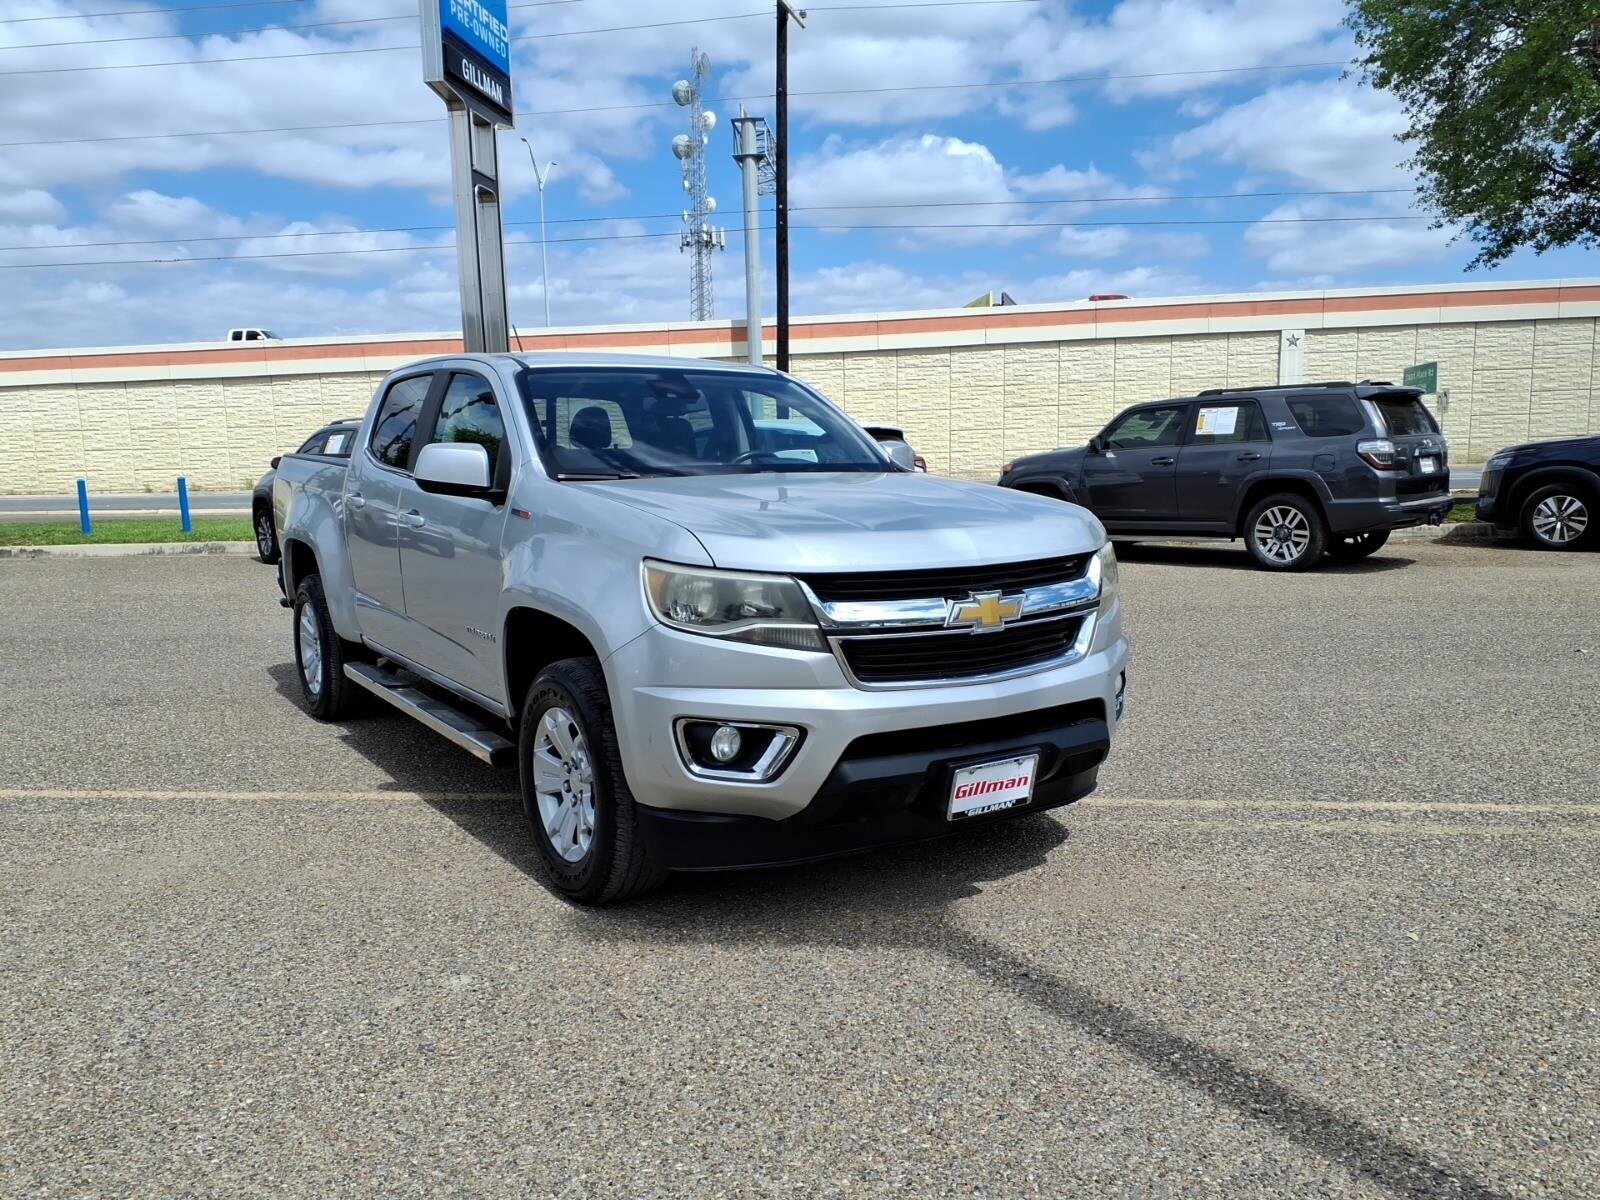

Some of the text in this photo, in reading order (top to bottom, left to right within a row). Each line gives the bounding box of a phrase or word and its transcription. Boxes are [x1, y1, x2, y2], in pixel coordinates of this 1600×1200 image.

[450, 0, 507, 58] PRE-OWNED
[461, 58, 503, 104] GILLMAN
[954, 776, 1029, 800] Gillman
